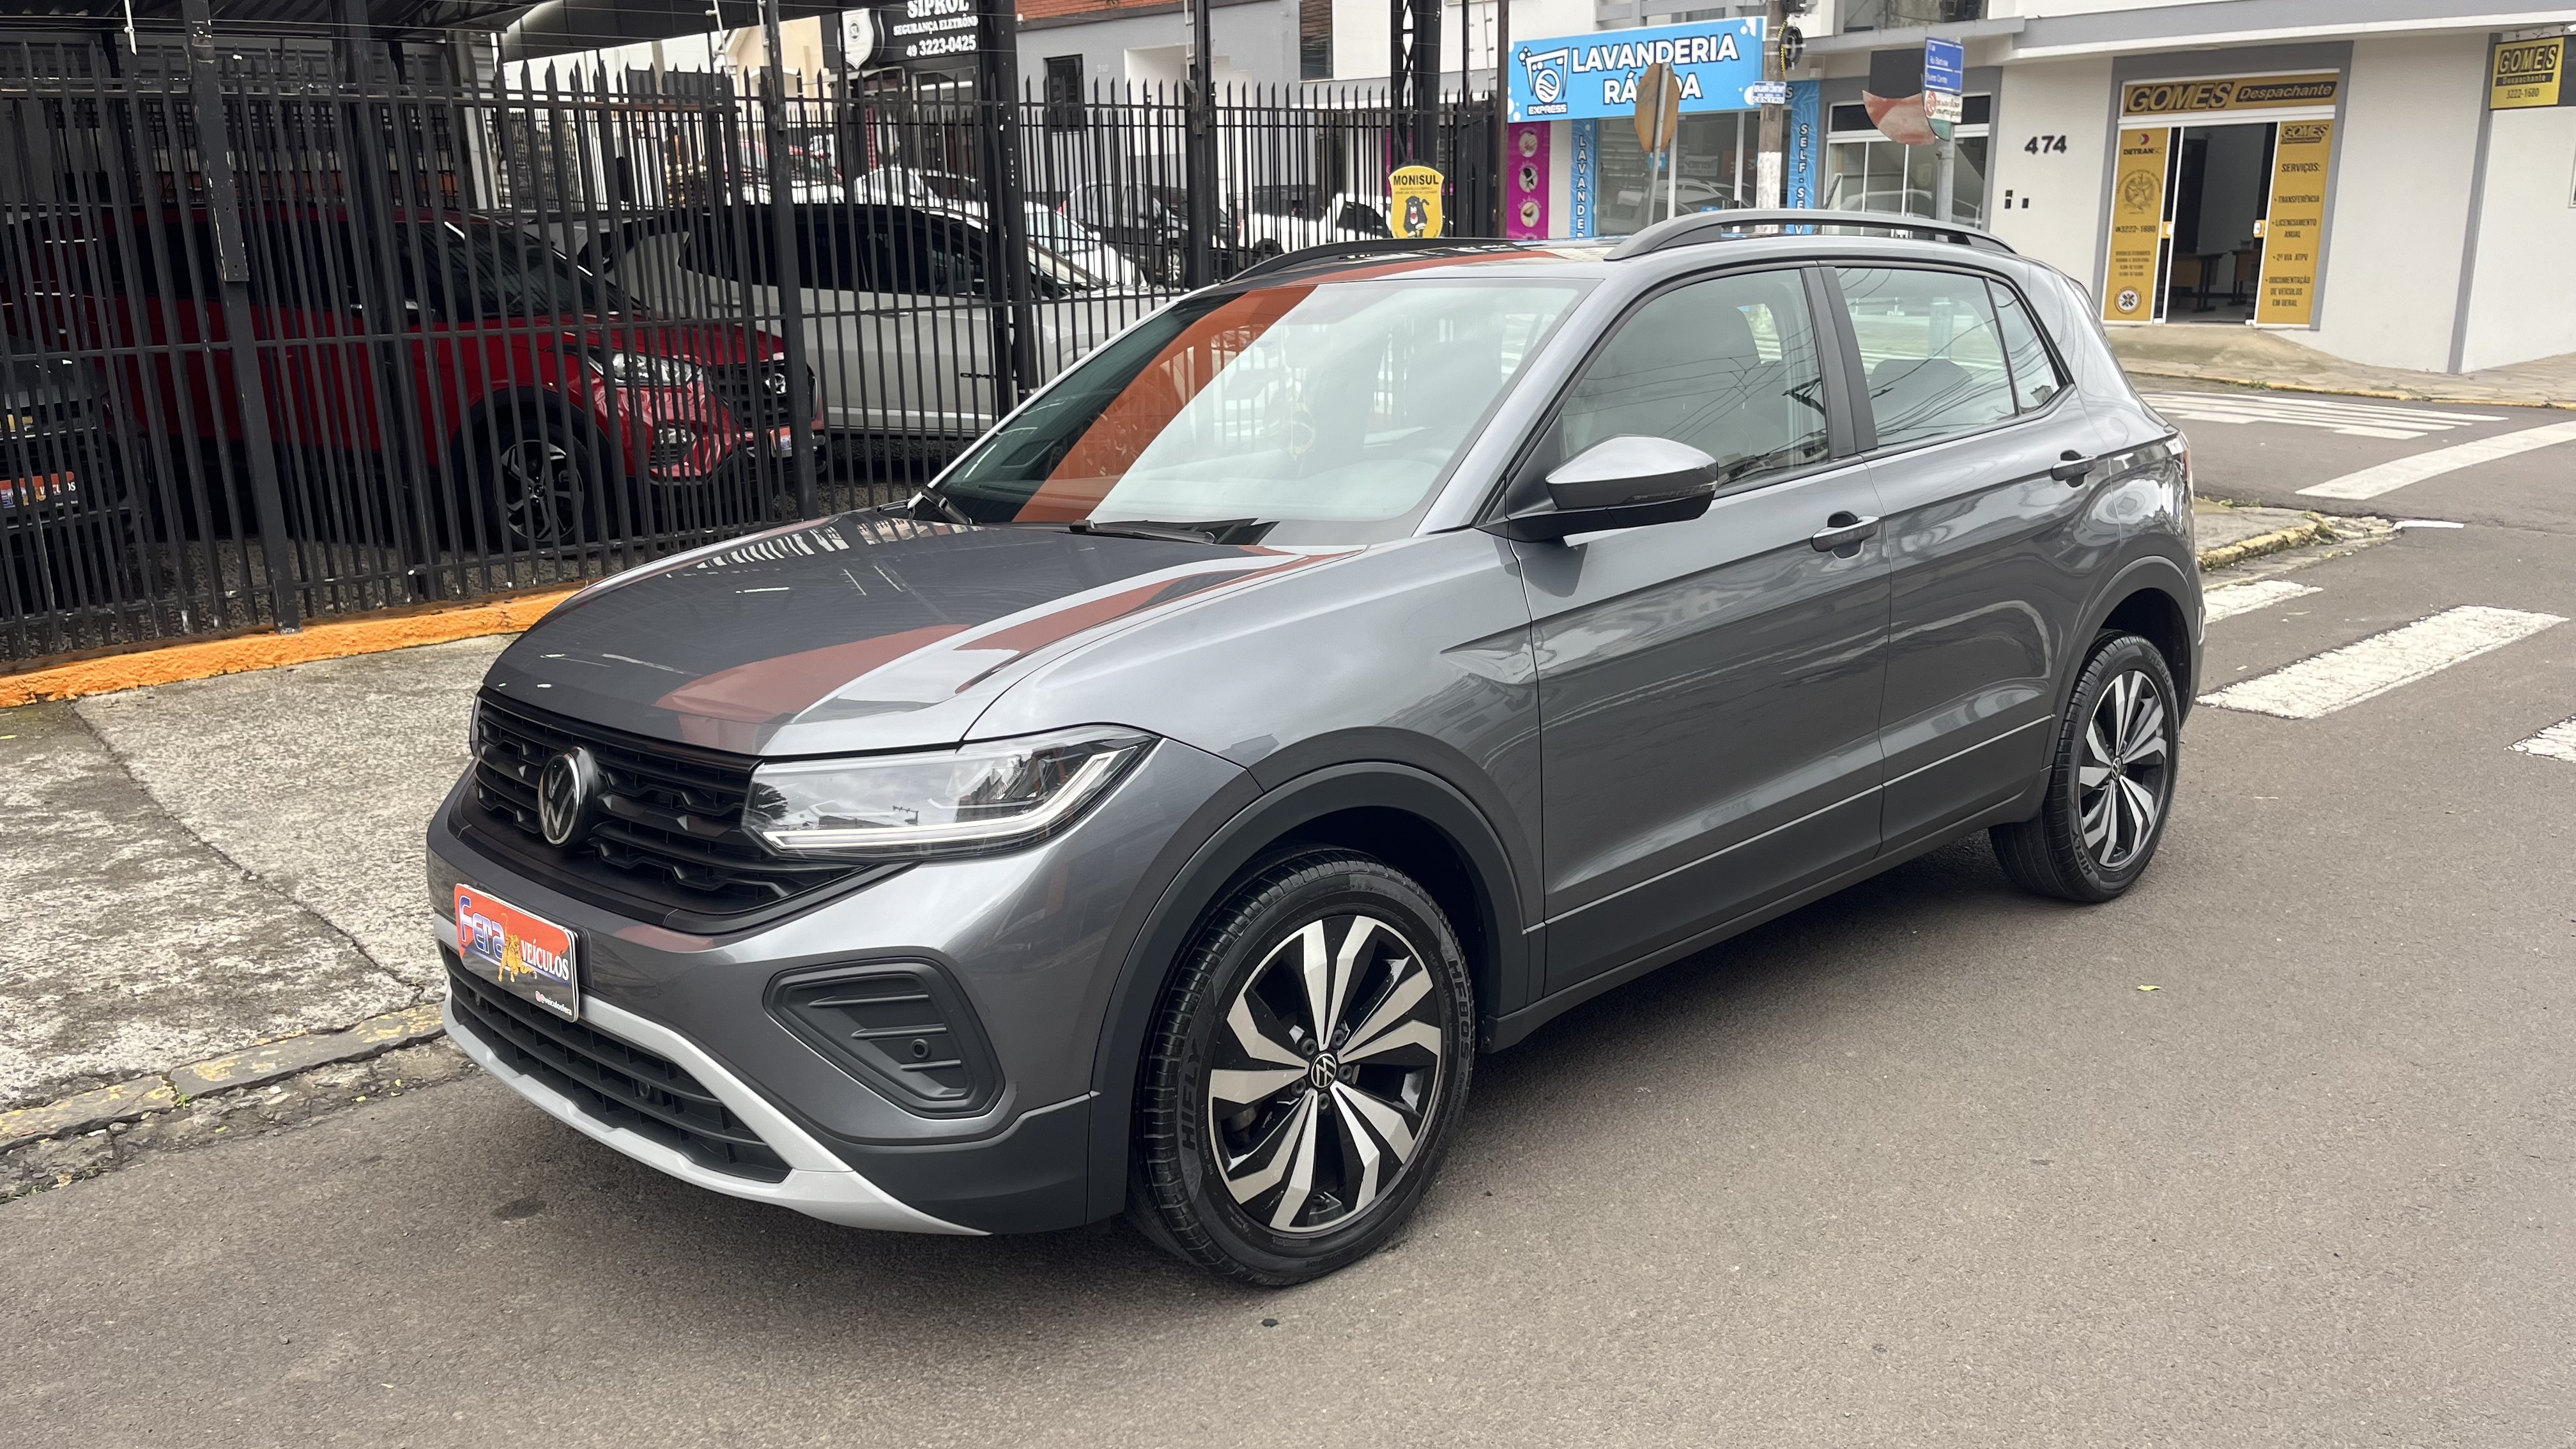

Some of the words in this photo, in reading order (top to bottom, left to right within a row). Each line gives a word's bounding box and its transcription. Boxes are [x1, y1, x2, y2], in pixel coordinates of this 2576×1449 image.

[907, 0, 970, 19] SIPROL
[893, 20, 939, 36] SEGURANÇA
[906, 44, 918, 57] 49
[919, 34, 977, 56] 3223-0425
[1572, 33, 1740, 73] LAVANDERIA
[2500, 45, 2557, 73] GOMES
[1604, 70, 1703, 105] RÁA
[2126, 82, 2235, 112] GOMES
[2239, 84, 2333, 102] Despachante
[1528, 103, 1567, 116] EXPRESS
[2024, 134, 2067, 155] 474
[2281, 124, 2330, 137] GOMES
[1393, 174, 1439, 186] MONISUL
[2071, 828, 2092, 875] HIFLY
[459, 895, 505, 960] Fera
[520, 939, 569, 981] VEÍCULOS
[1181, 1037, 1201, 1151] HIFLY
